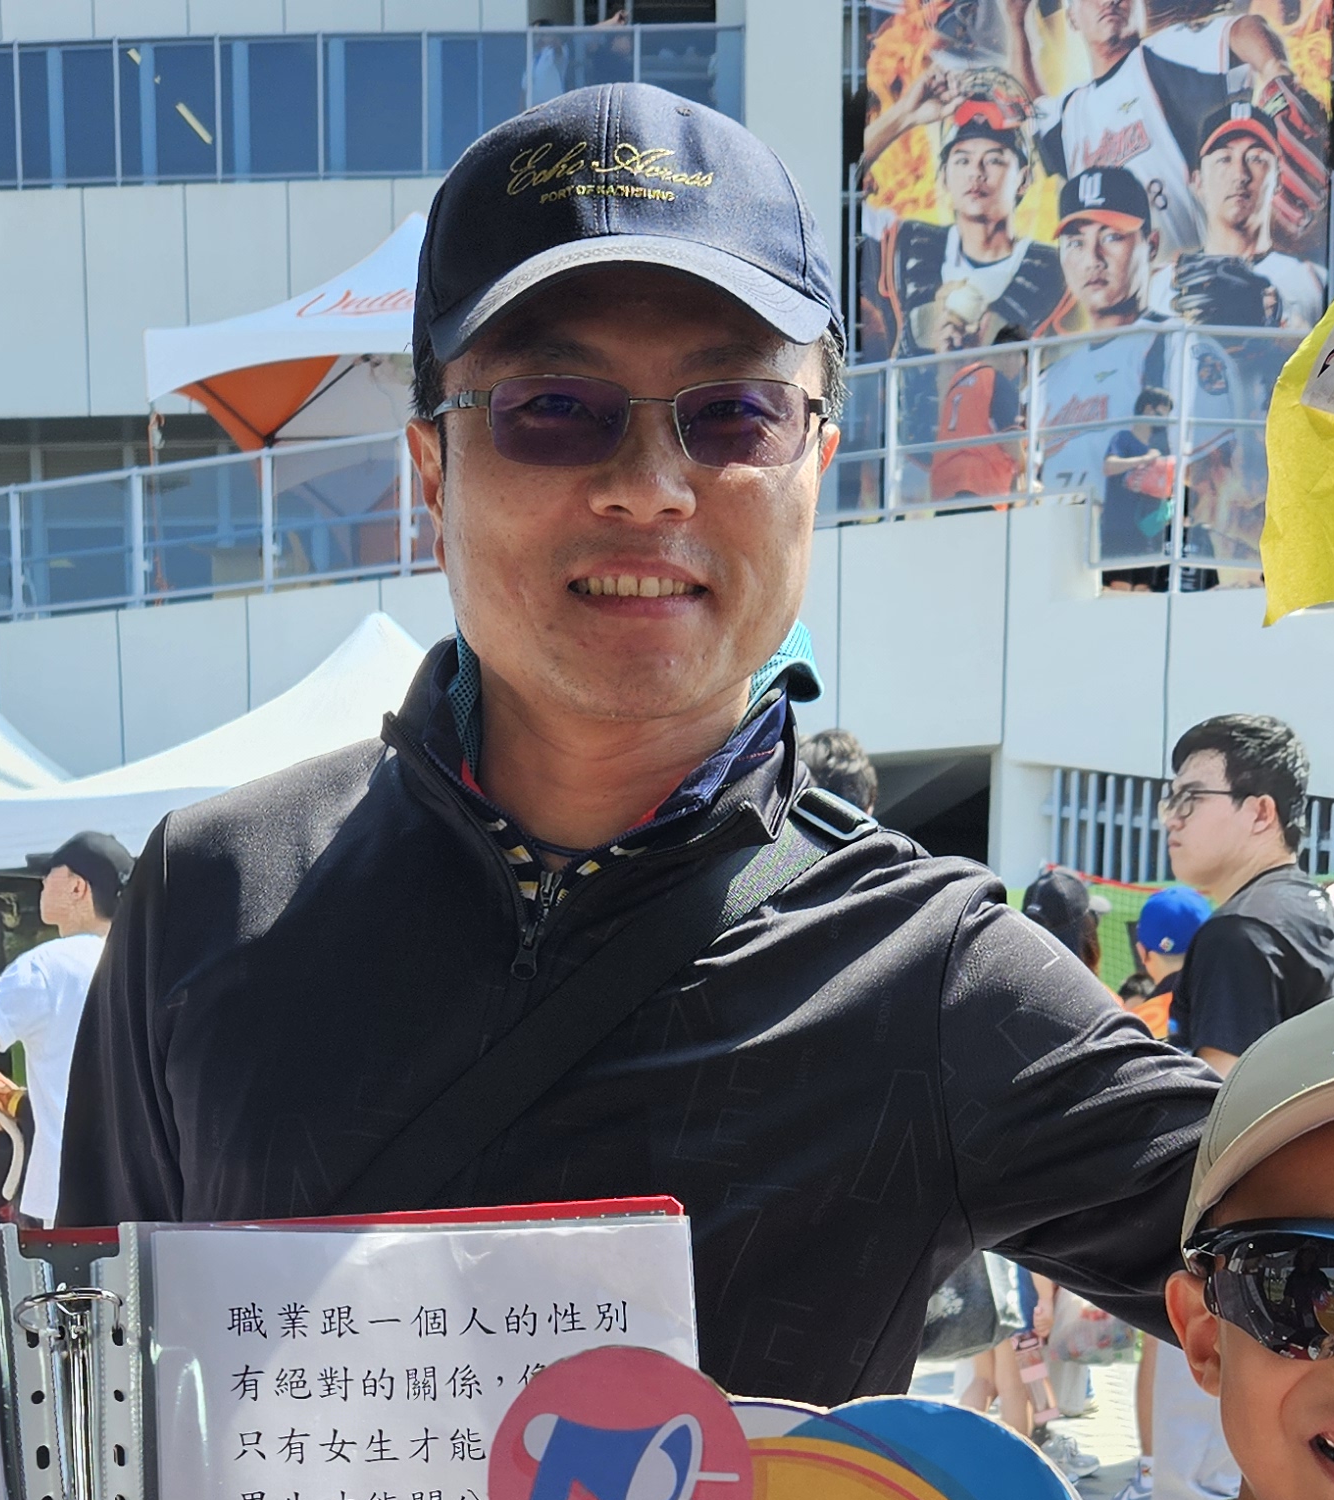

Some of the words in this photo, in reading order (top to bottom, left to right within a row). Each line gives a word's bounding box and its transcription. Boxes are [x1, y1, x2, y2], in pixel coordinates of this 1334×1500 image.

[226, 1298, 630, 1341] 職業跟一個人的性別
